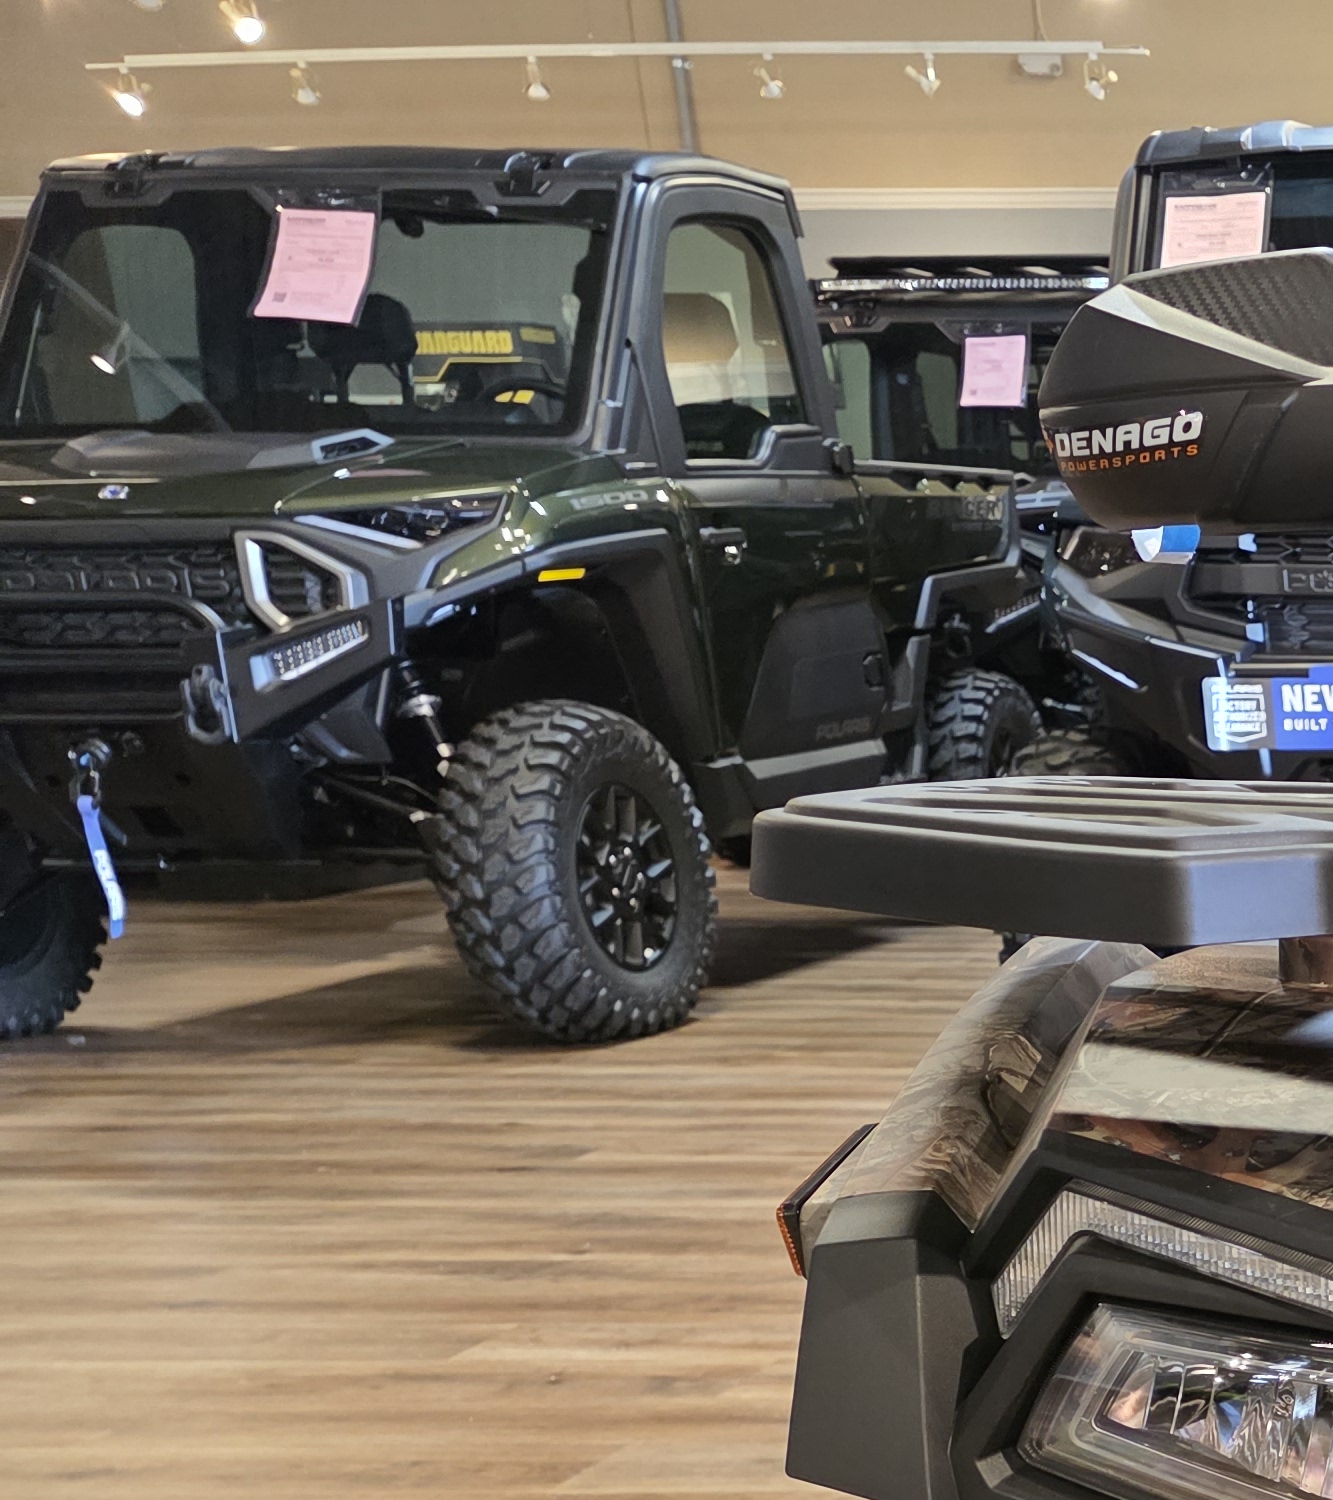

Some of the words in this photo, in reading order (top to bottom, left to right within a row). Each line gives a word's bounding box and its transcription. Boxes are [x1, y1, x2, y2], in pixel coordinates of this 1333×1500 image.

[415, 329, 514, 355] ANGUARD
[1054, 410, 1204, 458] DENAGO
[1060, 443, 1199, 473] POWERSPORTS
[1283, 717, 1328, 732] BUILT
